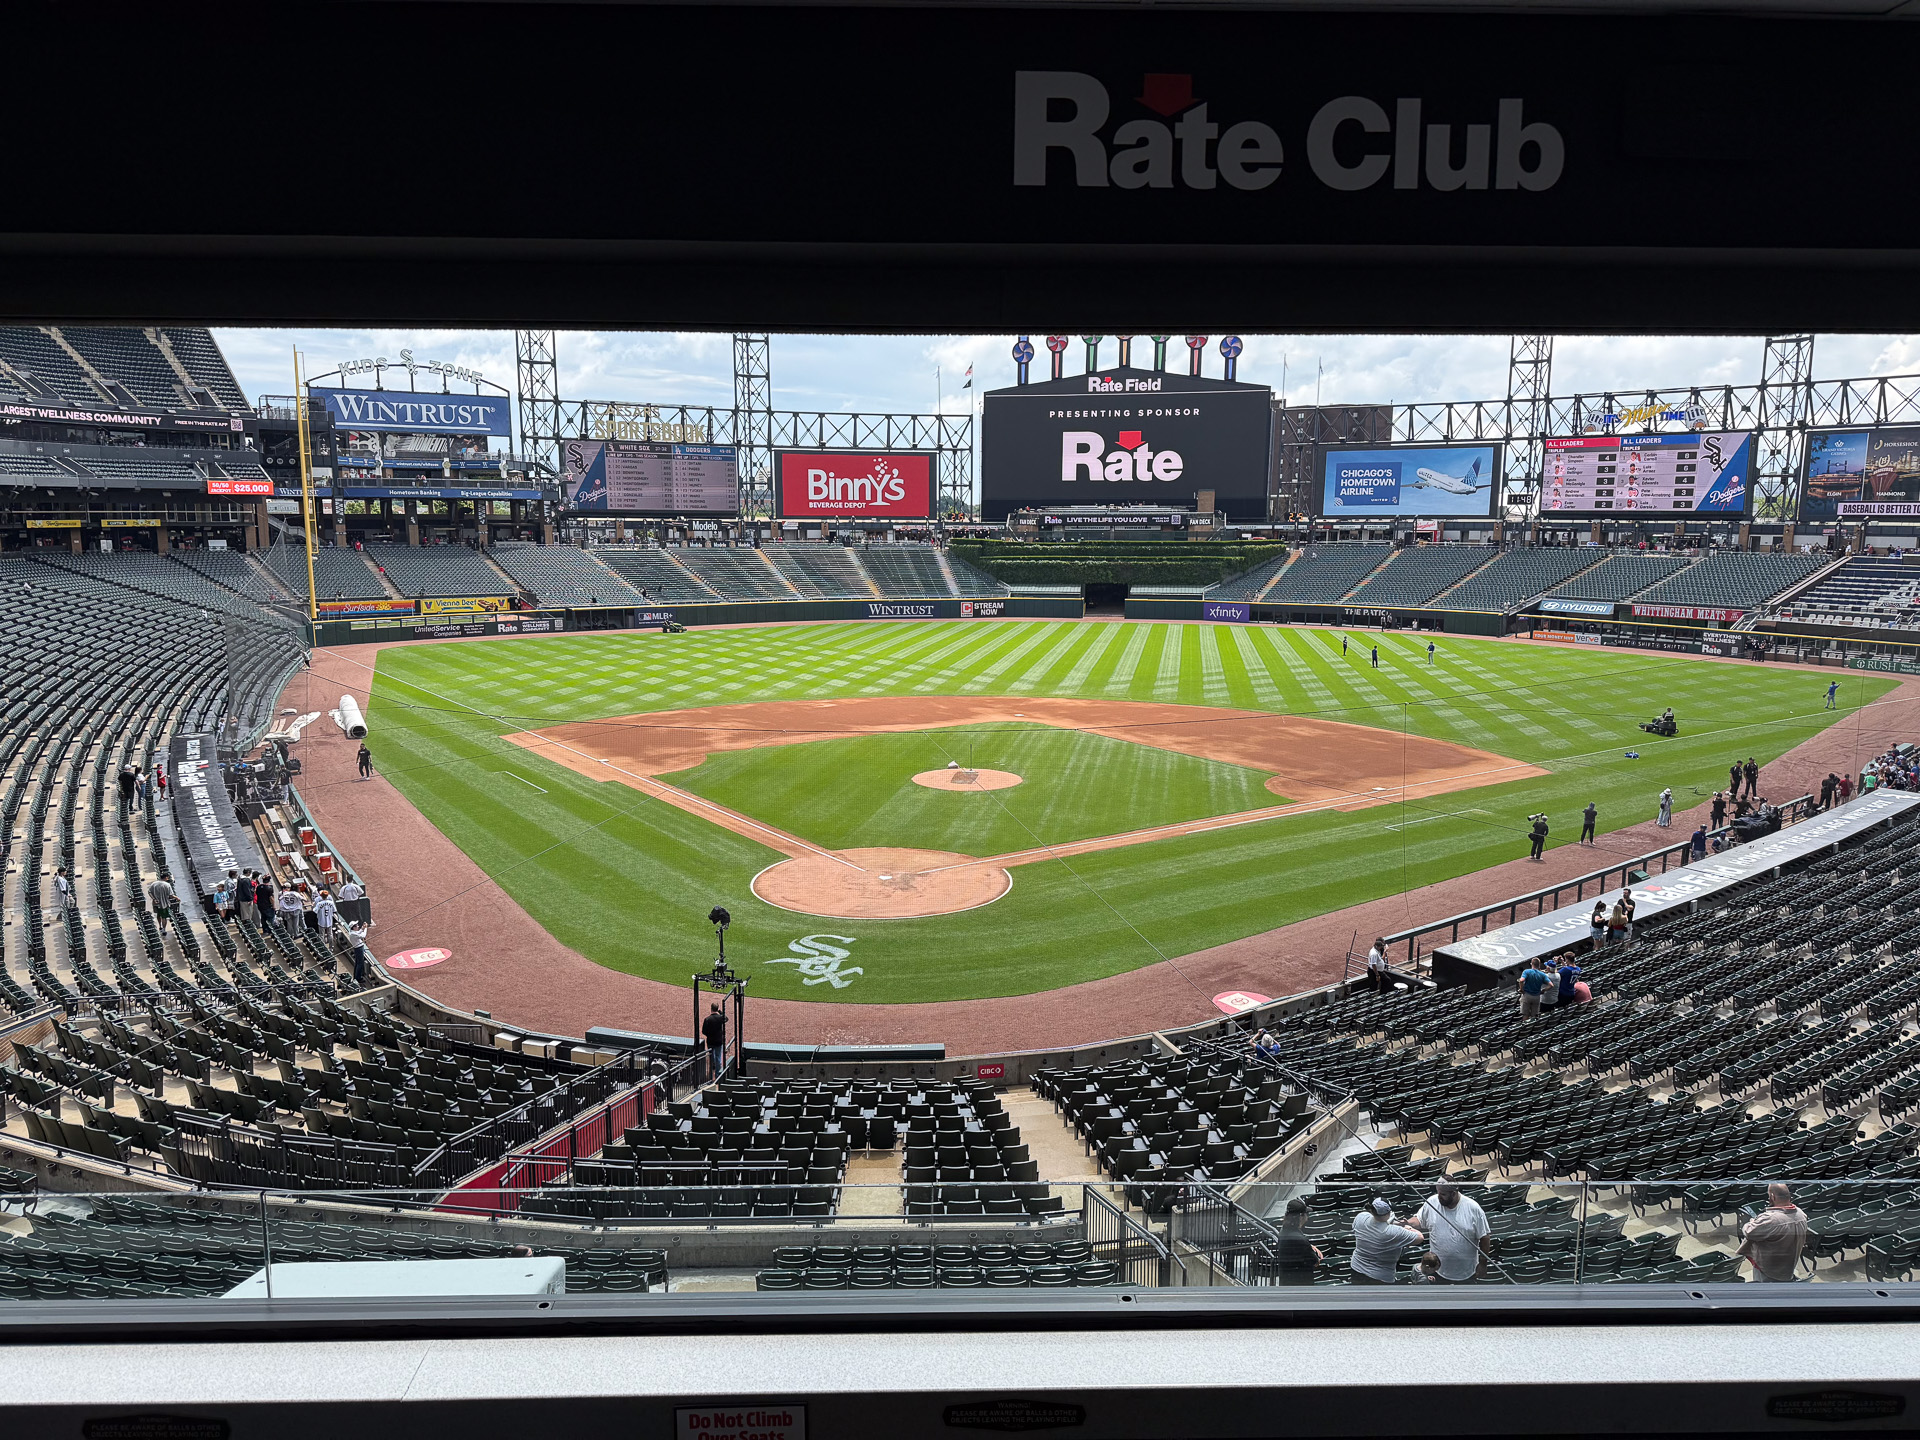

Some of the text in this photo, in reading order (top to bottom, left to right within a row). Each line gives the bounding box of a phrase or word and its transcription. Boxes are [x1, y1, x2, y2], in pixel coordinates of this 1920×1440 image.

[1014, 70, 1565, 192] Rate Club
[338, 357, 482, 385] KIDS ZONE
[1088, 377, 1161, 392] Rate Field
[0, 404, 161, 426] LARGEST WELLNESS COMMUNITY
[594, 404, 661, 418] CAESARS
[1049, 408, 1200, 418] PRESENTING SPONSOR
[1603, 403, 1685, 427] IT'S Miller TIME
[594, 420, 706, 442] SPORTSBOOK
[1061, 431, 1183, 482] Rate
[1341, 469, 1393, 478] CHICAGO'S
[807, 467, 906, 506] Binny's
[1340, 478, 1396, 487] HOMETOWN
[234, 484, 269, 493] $25,000
[389, 489, 441, 498] Hometown Banking
[460, 490, 513, 498] Big-League Capabilities
[1339, 488, 1374, 496] AIRLINE
[1709, 484, 1746, 504] Dodgers
[579, 487, 607, 502] Dodgers
[1842, 504, 1912, 514] BASEBALL IS BETTER
[1044, 515, 1062, 524] Rate
[692, 520, 718, 531] Modelo
[343, 603, 375, 613] Surfside
[868, 603, 935, 615] WINTRUST
[1209, 607, 1243, 619] xfinity
[1345, 608, 1361, 616] THE
[1560, 603, 1608, 613] HYUNDAI
[1634, 605, 1694, 619] WHITTINGHAM
[1697, 610, 1727, 621] MEATS
[652, 612, 673, 620] MLB+
[414, 624, 461, 633] UnitedService
[498, 623, 518, 633] Rate
[1702, 632, 1742, 640] EVERYTHING
[1701, 644, 1722, 655] Rate
[1867, 659, 1897, 671] RUSH
[207, 837, 233, 858] WHITE
[216, 857, 240, 872] SOX
[980, 1067, 996, 1075] CIBC
[689, 1410, 793, 1430] Do Not Climb
